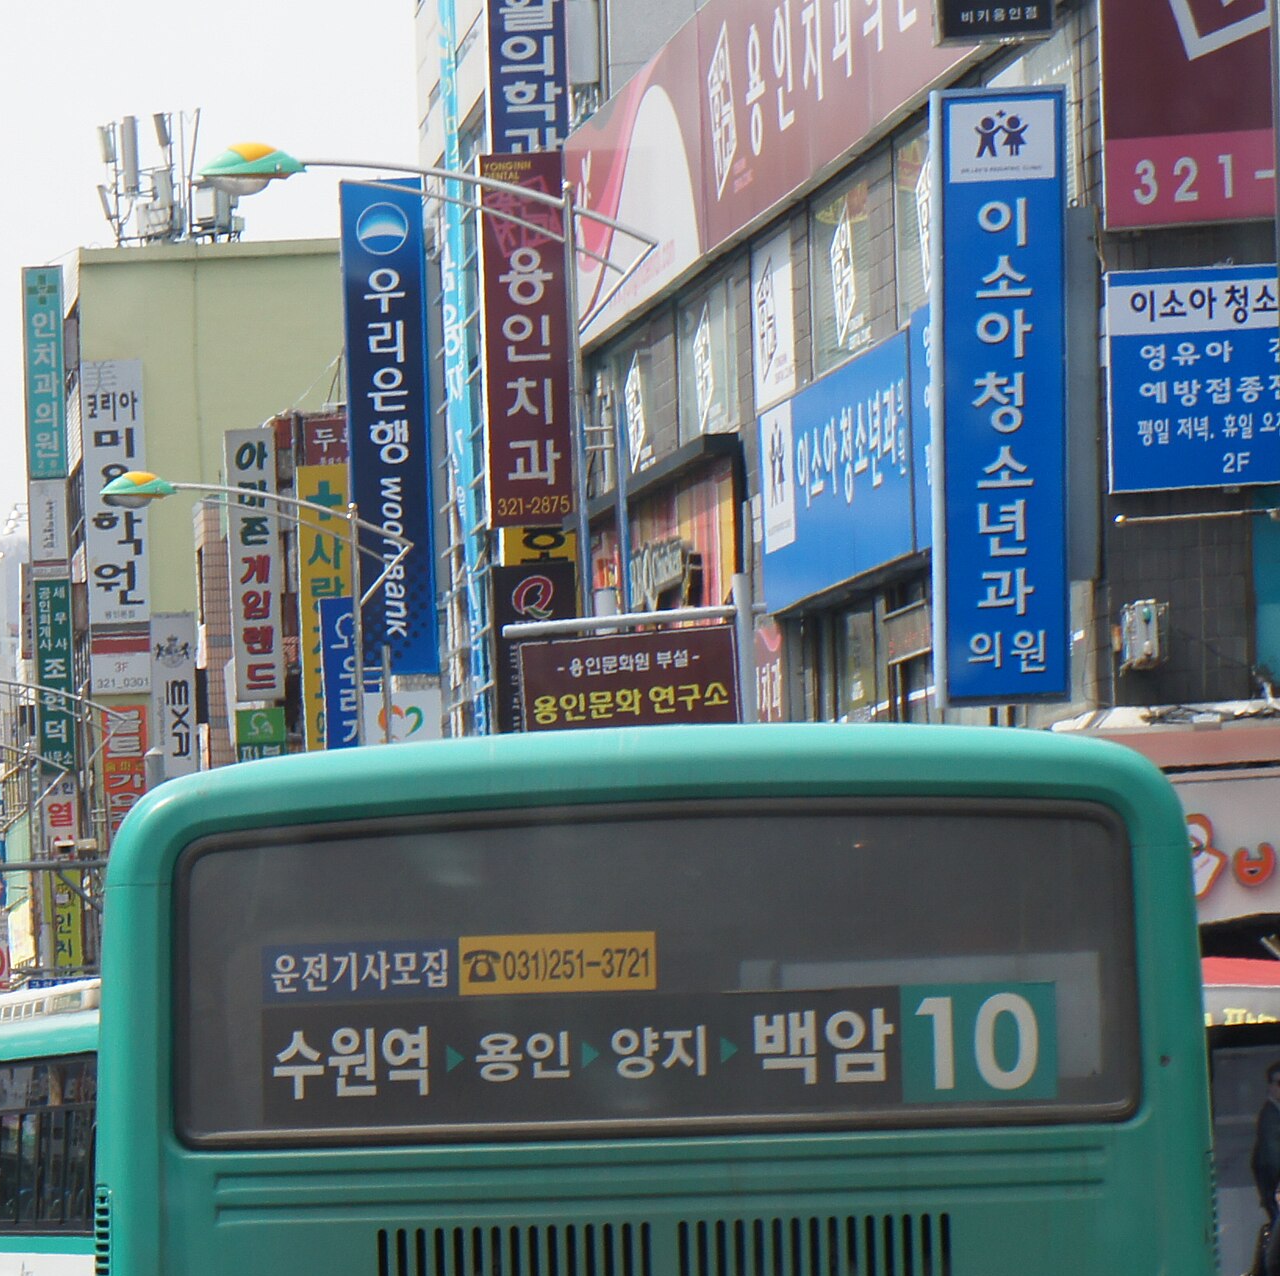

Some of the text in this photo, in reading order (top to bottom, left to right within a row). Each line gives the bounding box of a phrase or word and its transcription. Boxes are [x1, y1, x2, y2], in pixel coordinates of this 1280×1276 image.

[364, 267, 410, 465] 우리은행
[499, 247, 561, 486] 용인치과
[1140, 340, 1234, 371] 영유아
[971, 197, 1035, 617] 이소아청소년과
[1222, 414, 1253, 440] 휴일
[1223, 454, 1250, 473] 2F
[498, 495, 570, 516] 321-2875
[569, 650, 688, 677] 용인문화원 부설
[533, 682, 729, 724] 용인문화 연구소
[270, 949, 450, 993] 운전기사모집
[273, 993, 1041, 1100] 수원역 용인 양지 백암 10
